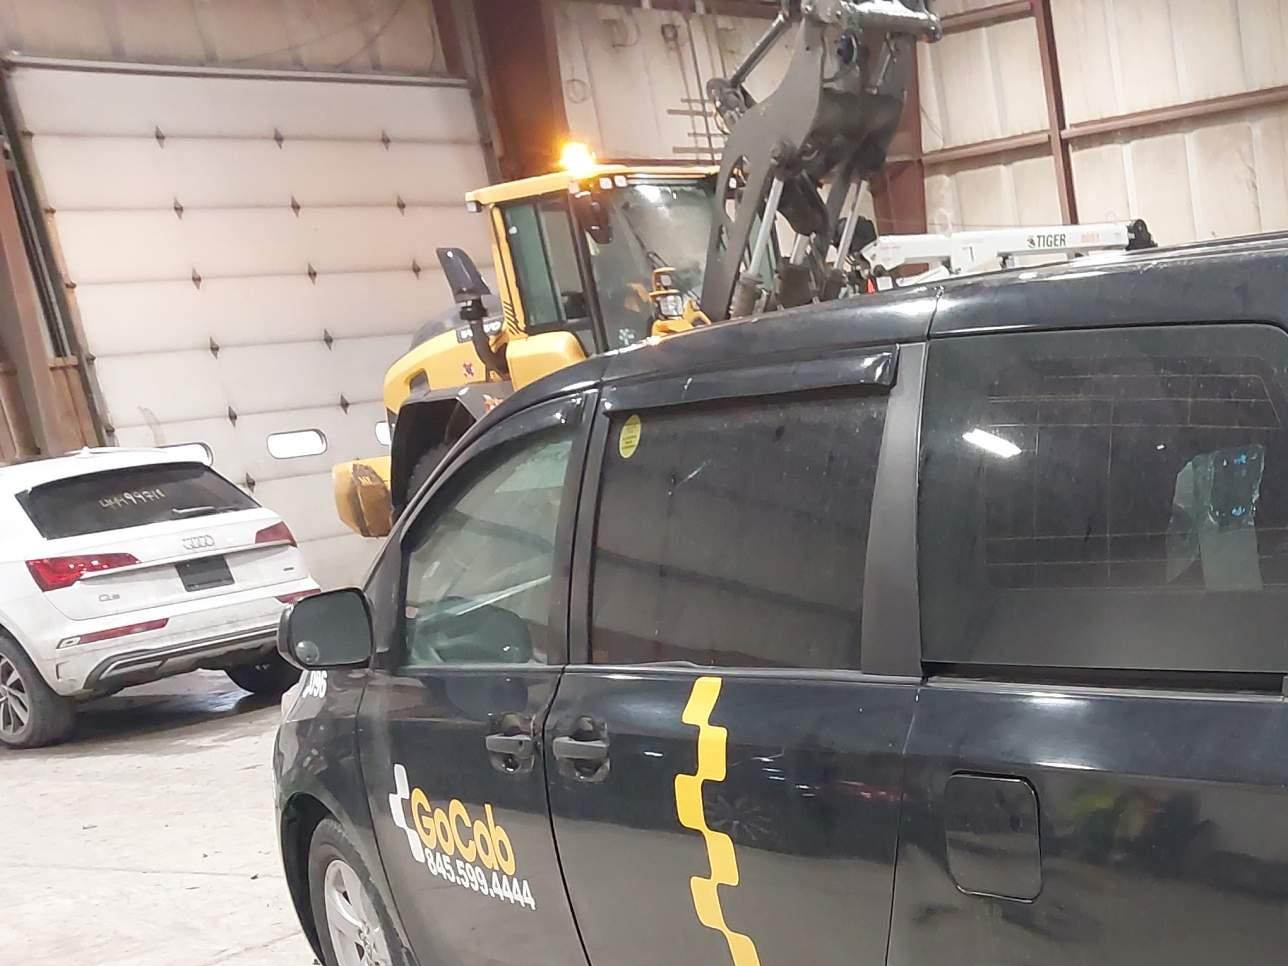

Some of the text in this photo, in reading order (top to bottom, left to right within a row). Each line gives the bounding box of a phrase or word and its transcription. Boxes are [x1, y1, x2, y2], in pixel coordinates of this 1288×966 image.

[1036, 233, 1066, 248] TIGER
[411, 788, 516, 876] GoCab
[424, 847, 536, 910] 845.599.4444
